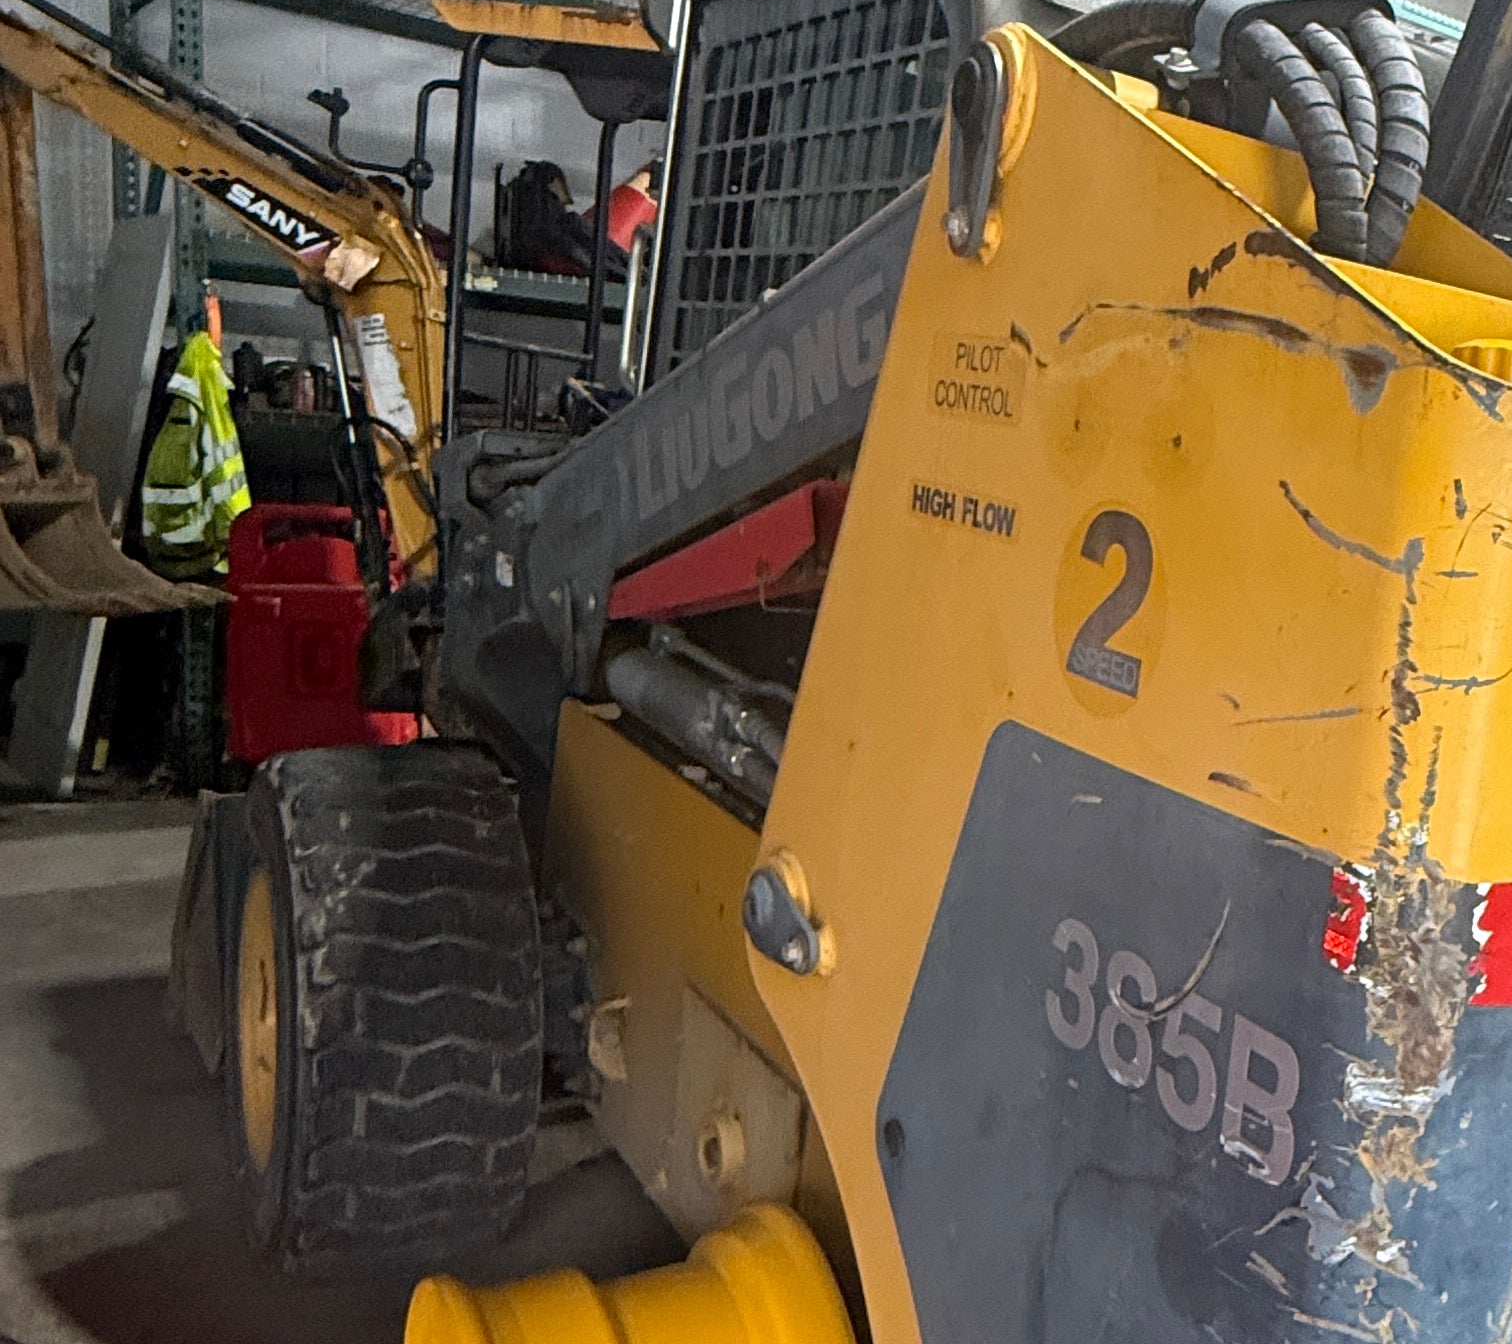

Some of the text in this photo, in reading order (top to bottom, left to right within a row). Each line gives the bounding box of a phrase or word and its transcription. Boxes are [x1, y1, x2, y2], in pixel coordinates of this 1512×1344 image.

[226, 183, 320, 246] SANY
[956, 342, 1005, 373] PILOT
[935, 379, 1014, 418] CONTROL
[912, 484, 1017, 537] HIGH FLOW
[1066, 510, 1154, 700] 2
[1073, 643, 1137, 690] SPEED
